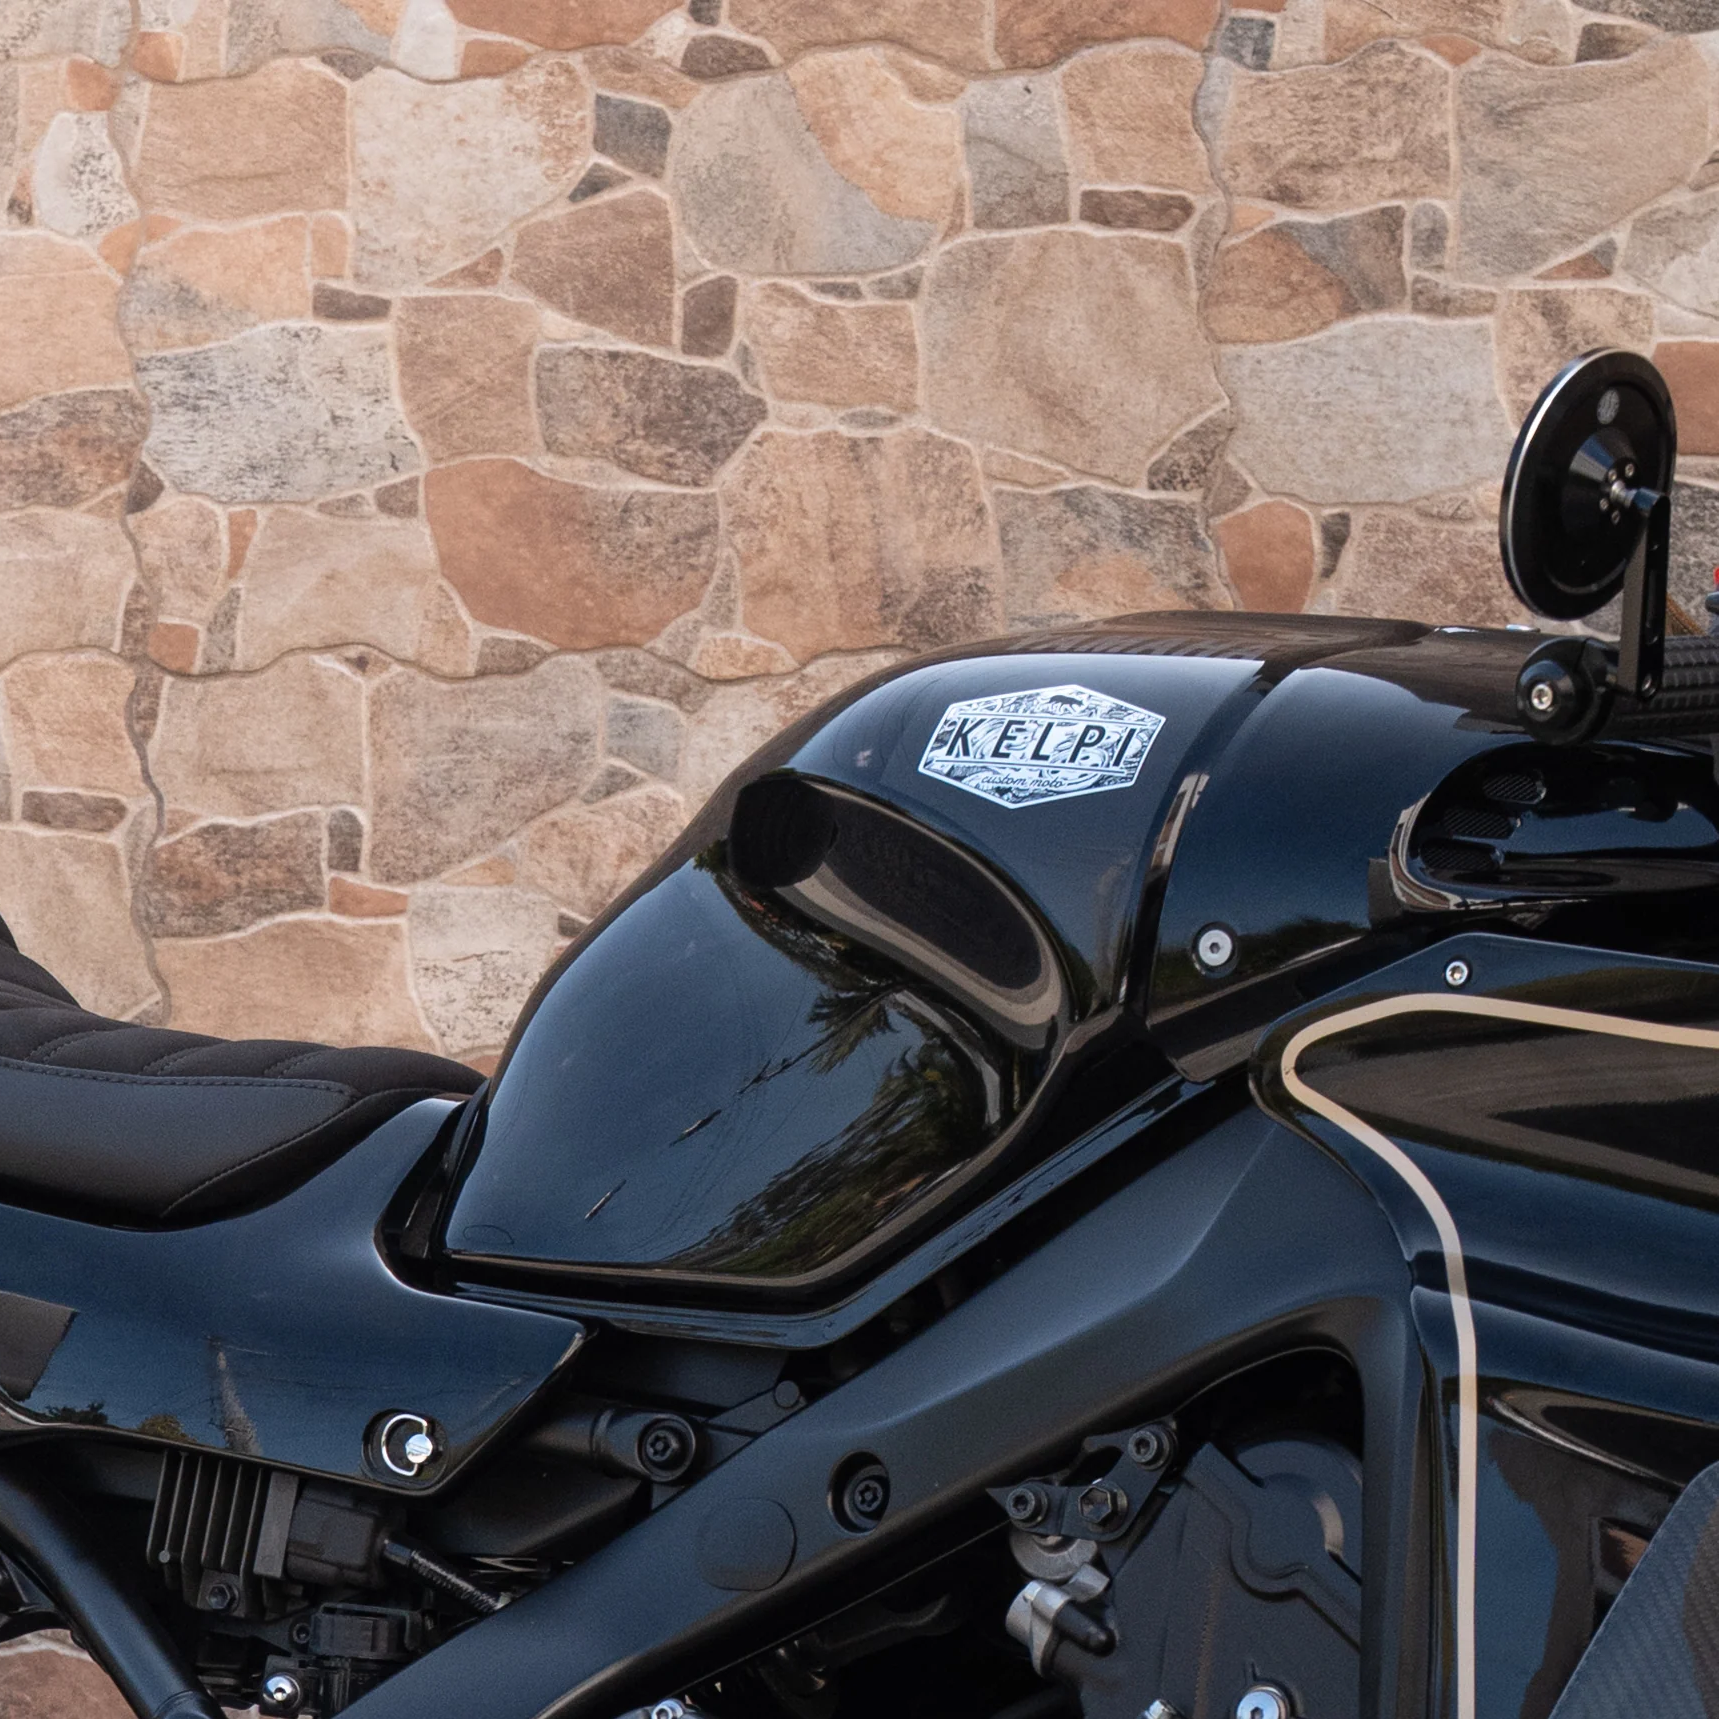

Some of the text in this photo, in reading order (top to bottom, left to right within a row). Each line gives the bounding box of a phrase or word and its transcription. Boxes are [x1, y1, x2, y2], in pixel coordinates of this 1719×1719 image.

[944, 717, 1137, 768] KELPI
[981, 773, 1067, 788] custom moto
